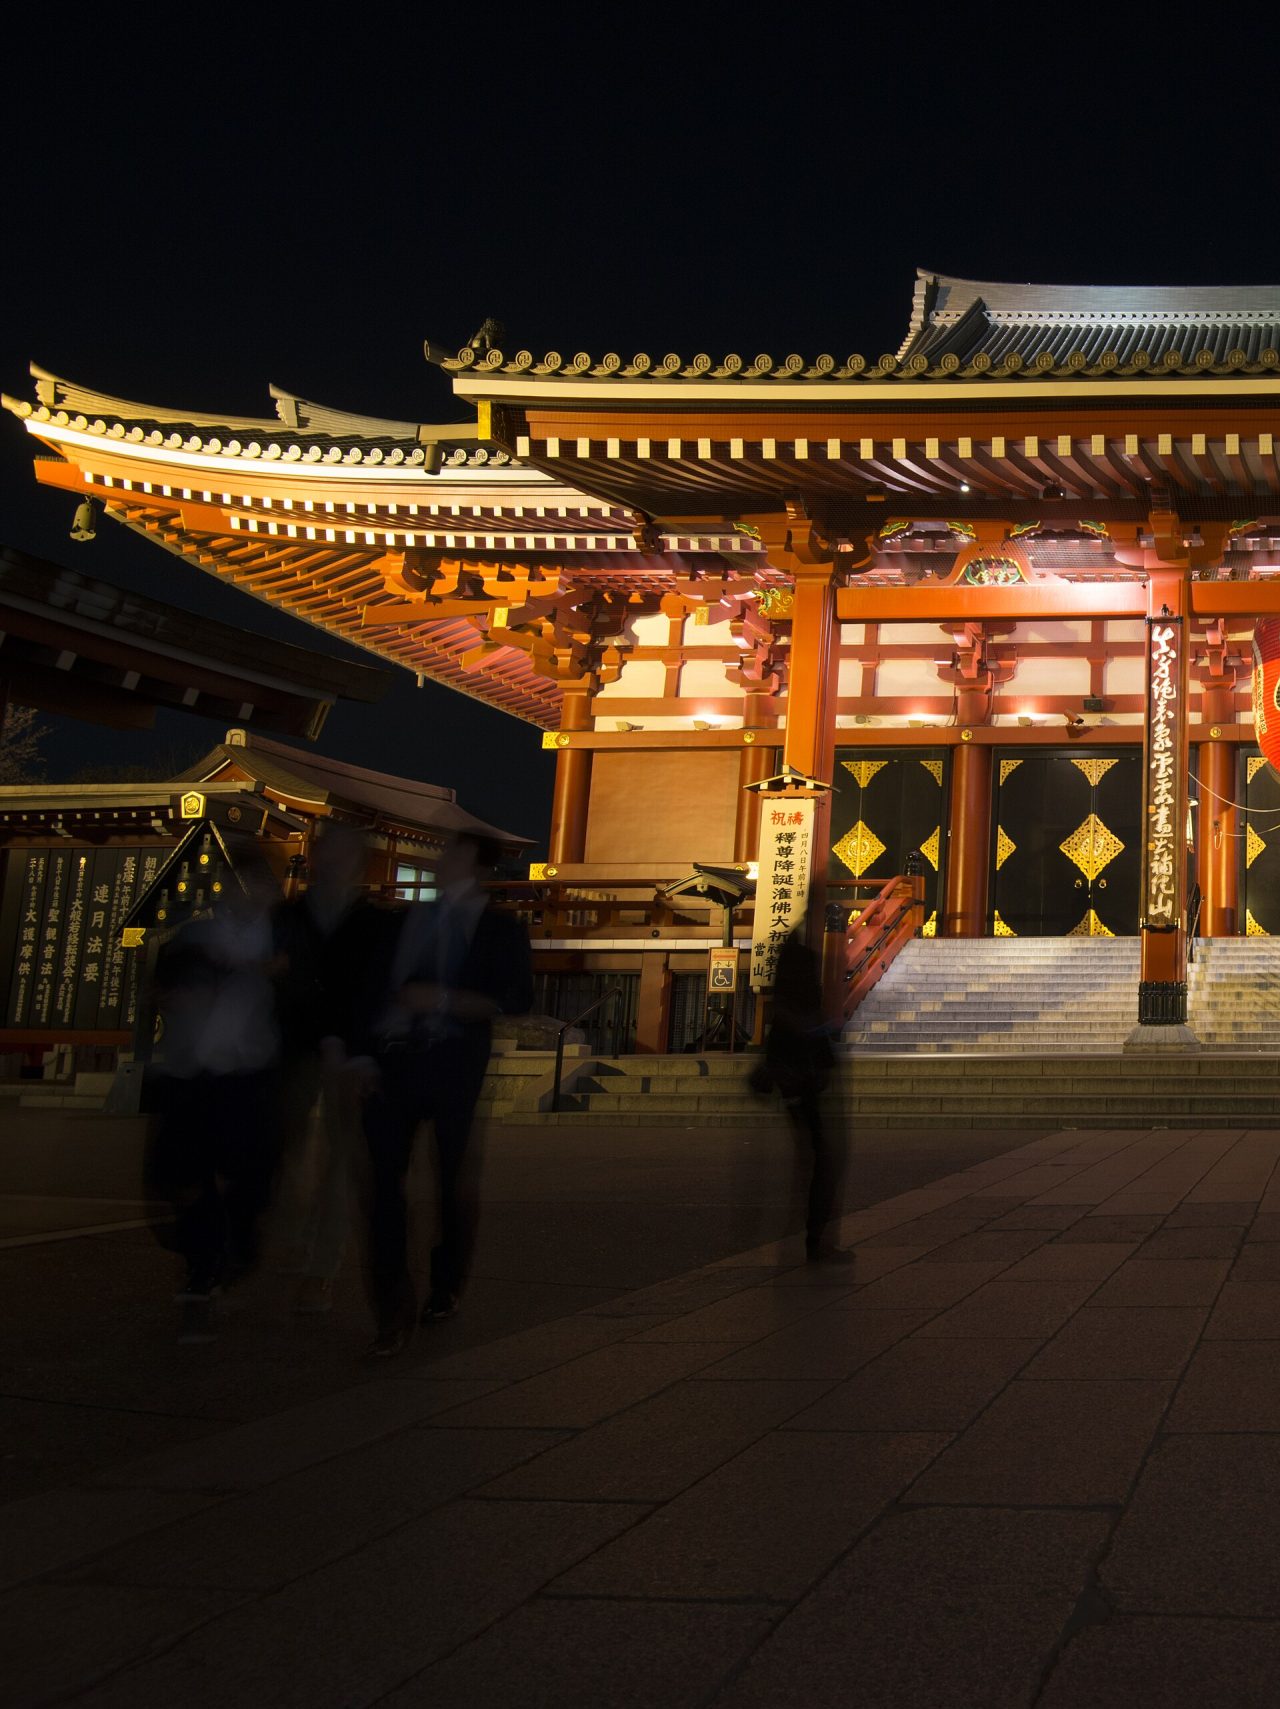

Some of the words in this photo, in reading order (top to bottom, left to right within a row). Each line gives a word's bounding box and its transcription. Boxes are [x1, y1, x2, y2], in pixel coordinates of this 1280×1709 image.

[796, 832, 809, 898] 四月八日午前十時
[83, 884, 109, 983] 連月法要
[753, 942, 766, 978] 當山
